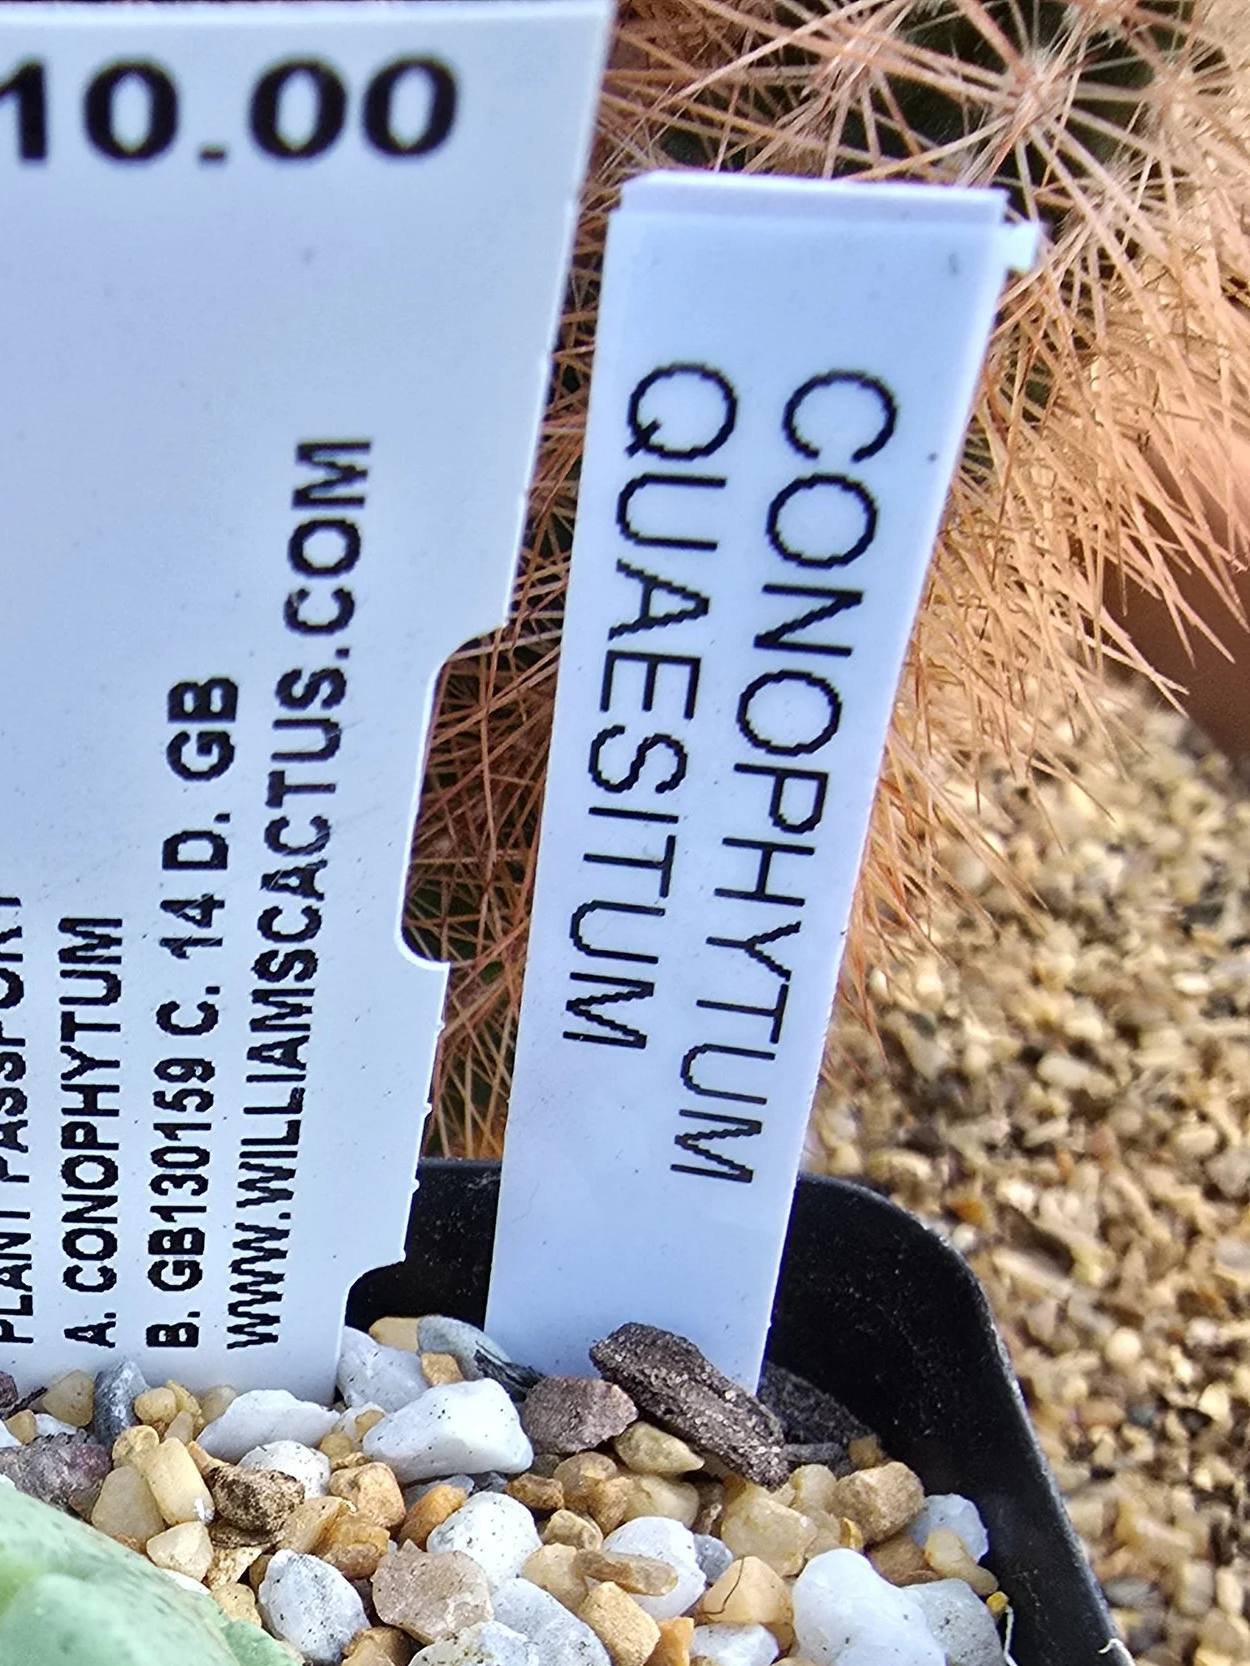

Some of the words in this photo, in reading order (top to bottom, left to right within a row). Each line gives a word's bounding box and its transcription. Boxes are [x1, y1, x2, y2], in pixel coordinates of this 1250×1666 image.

[166, 677, 239, 782] GB
[562, 361, 739, 1050] QUAESITUM
[669, 368, 899, 1185] CONOPHYTUM
[161, 812, 231, 871] D.
[159, 893, 226, 960] 14
[226, 440, 372, 1350] WWW.WILLIAMSCACTUS.COM
[155, 985, 221, 1036] C.
[57, 917, 123, 1293] CONOPHYTUM
[147, 1057, 216, 1292] GB130159
[63, 1311, 117, 1349] A.
[145, 1310, 201, 1348] B.
